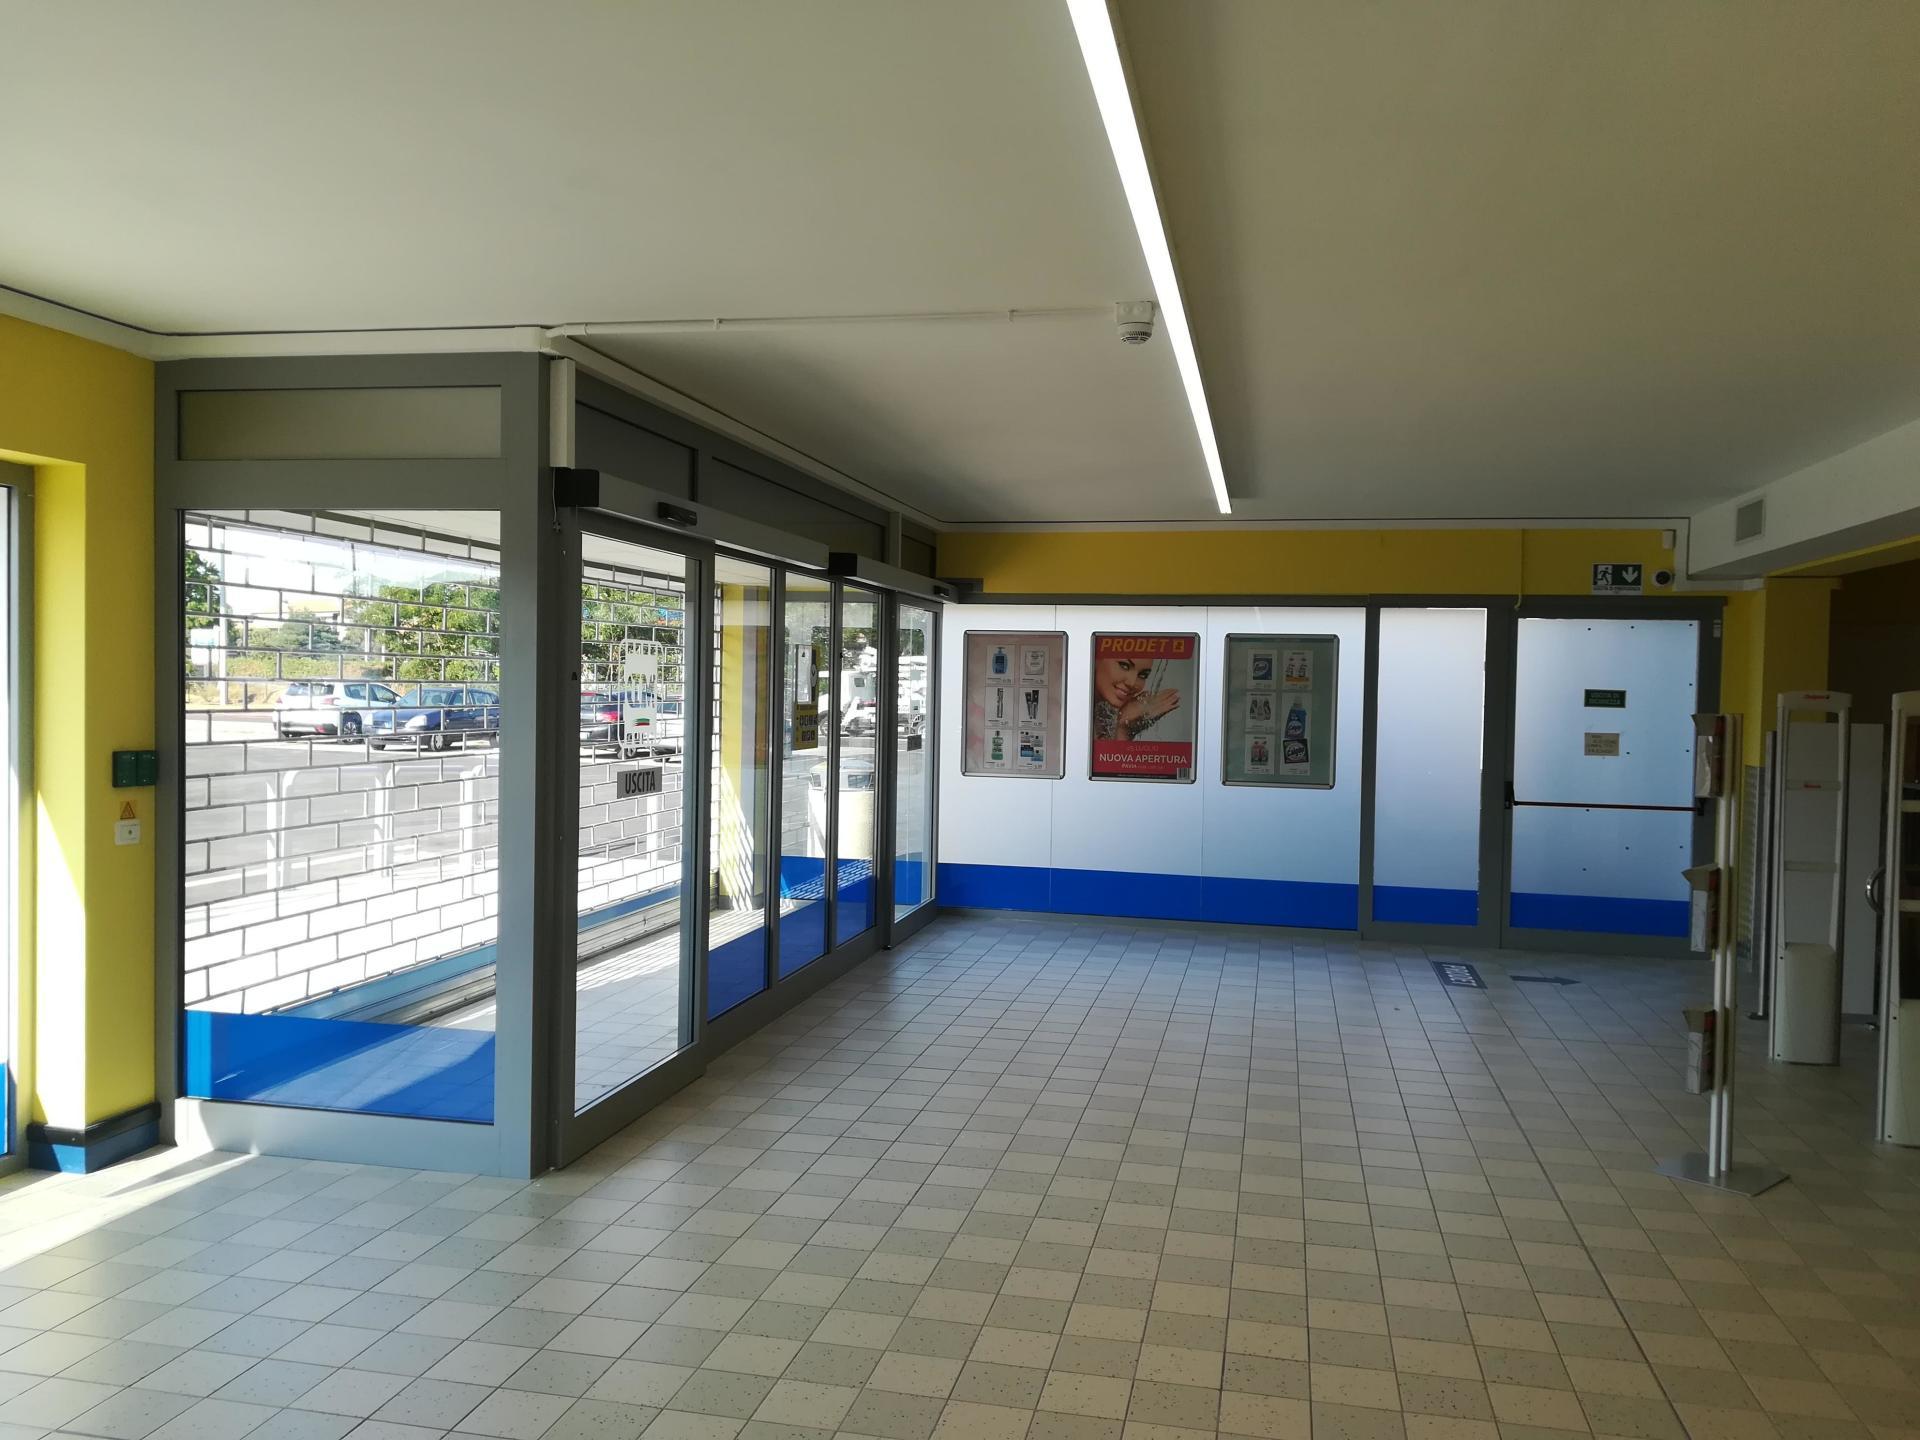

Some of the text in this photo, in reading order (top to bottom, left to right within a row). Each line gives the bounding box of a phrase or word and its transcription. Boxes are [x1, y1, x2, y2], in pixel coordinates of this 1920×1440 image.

[1100, 638, 1169, 652] PRODET
[1099, 753, 1187, 764] NUOVA APERTURA
[625, 771, 656, 794] USCITA
